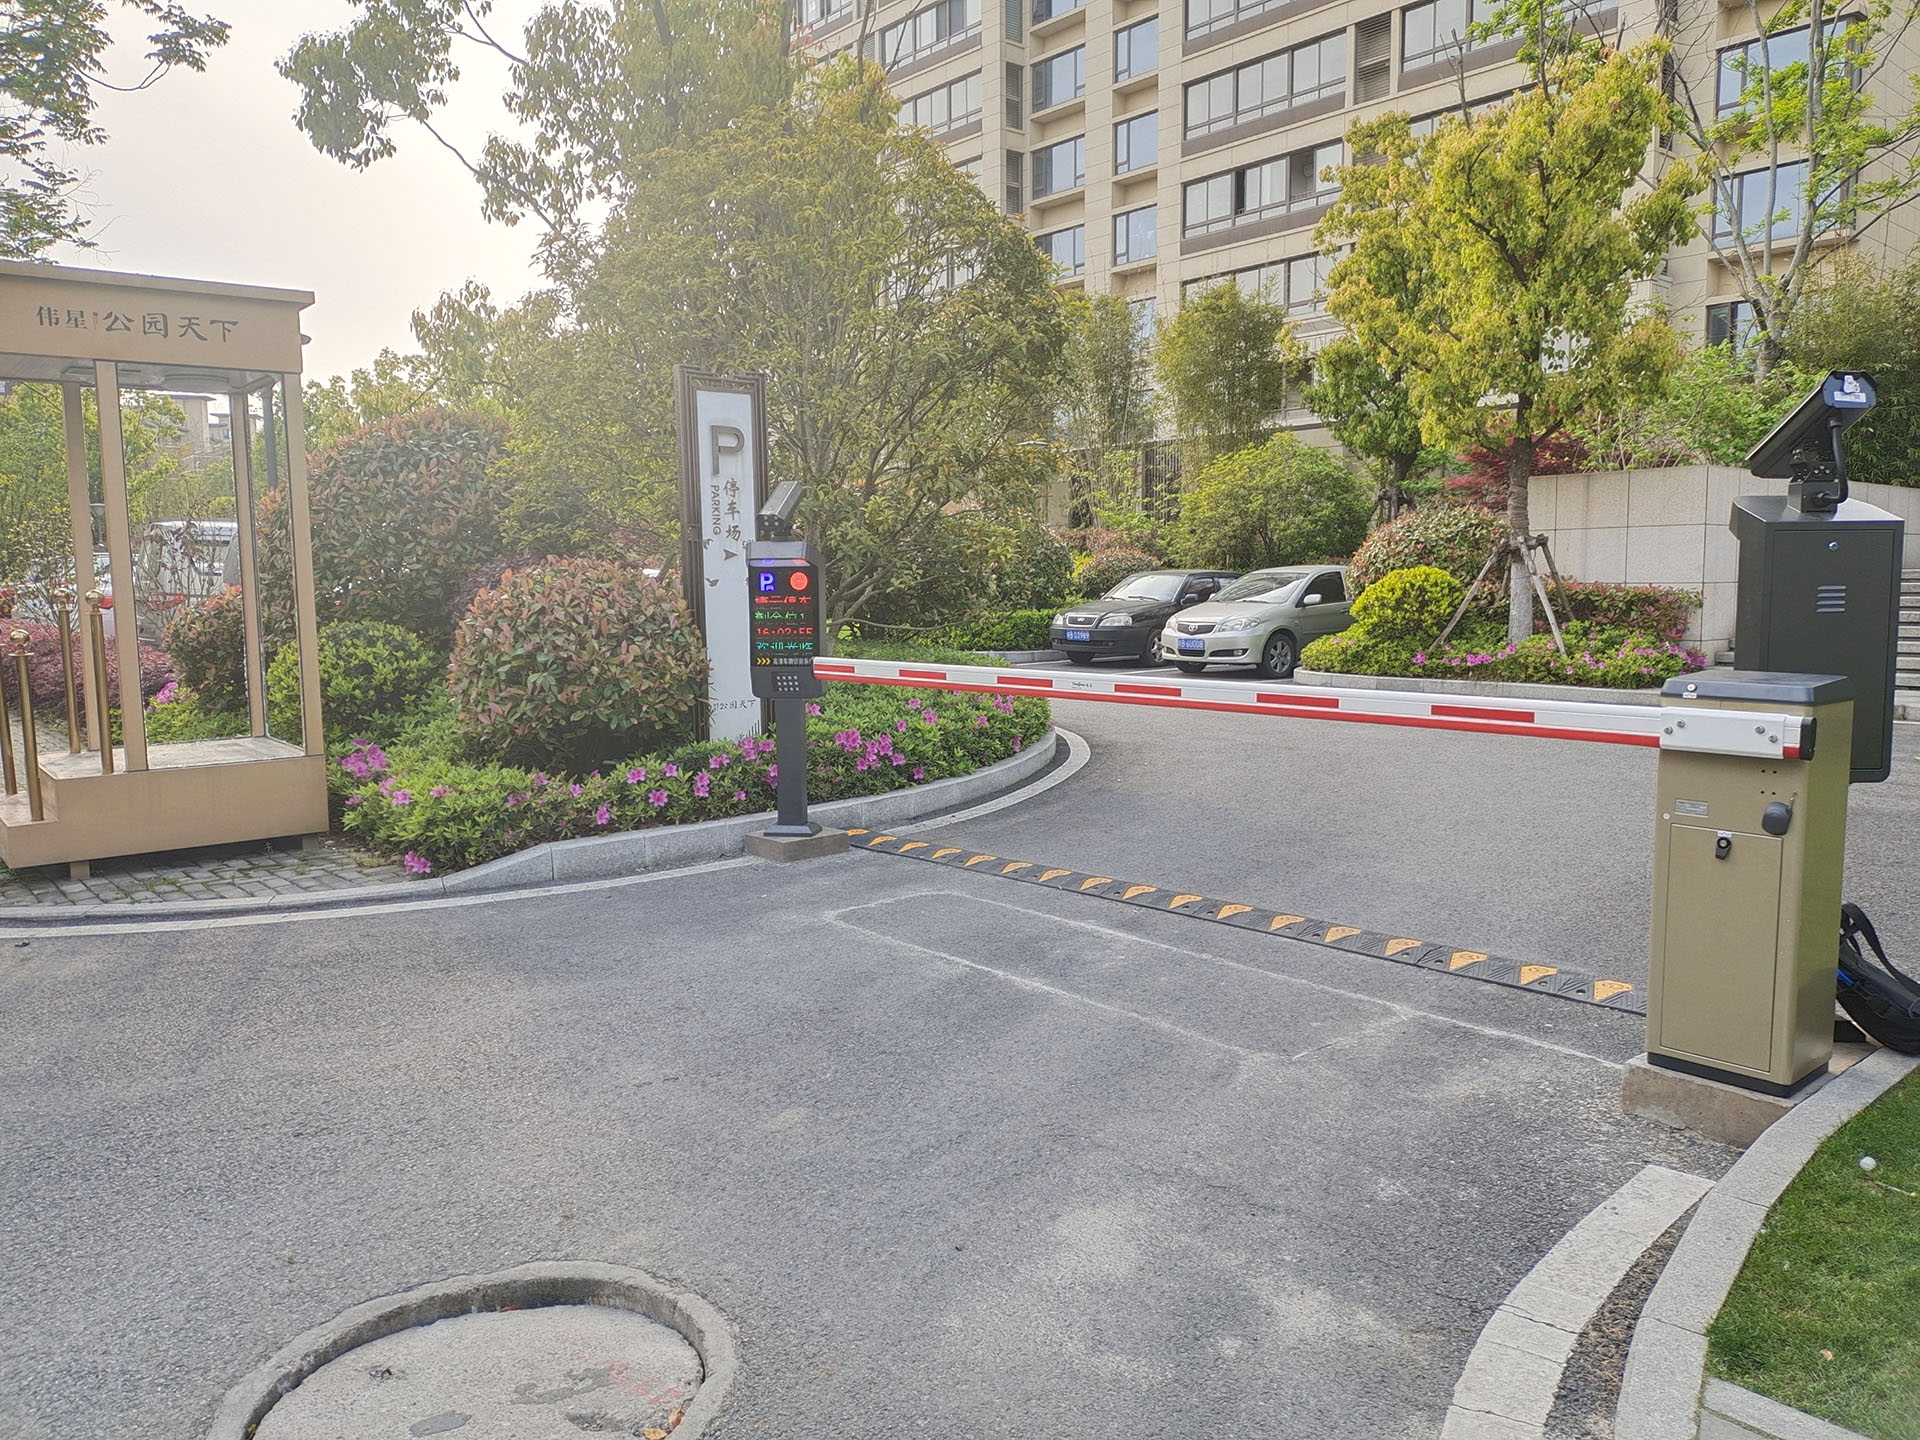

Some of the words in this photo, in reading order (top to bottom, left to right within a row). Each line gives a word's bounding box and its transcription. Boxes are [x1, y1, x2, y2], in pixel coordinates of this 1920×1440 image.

[103, 311, 239, 343] 公园天下
[711, 425, 745, 474] P
[711, 485, 721, 535] PARKING
[723, 478, 741, 541] 停车场
